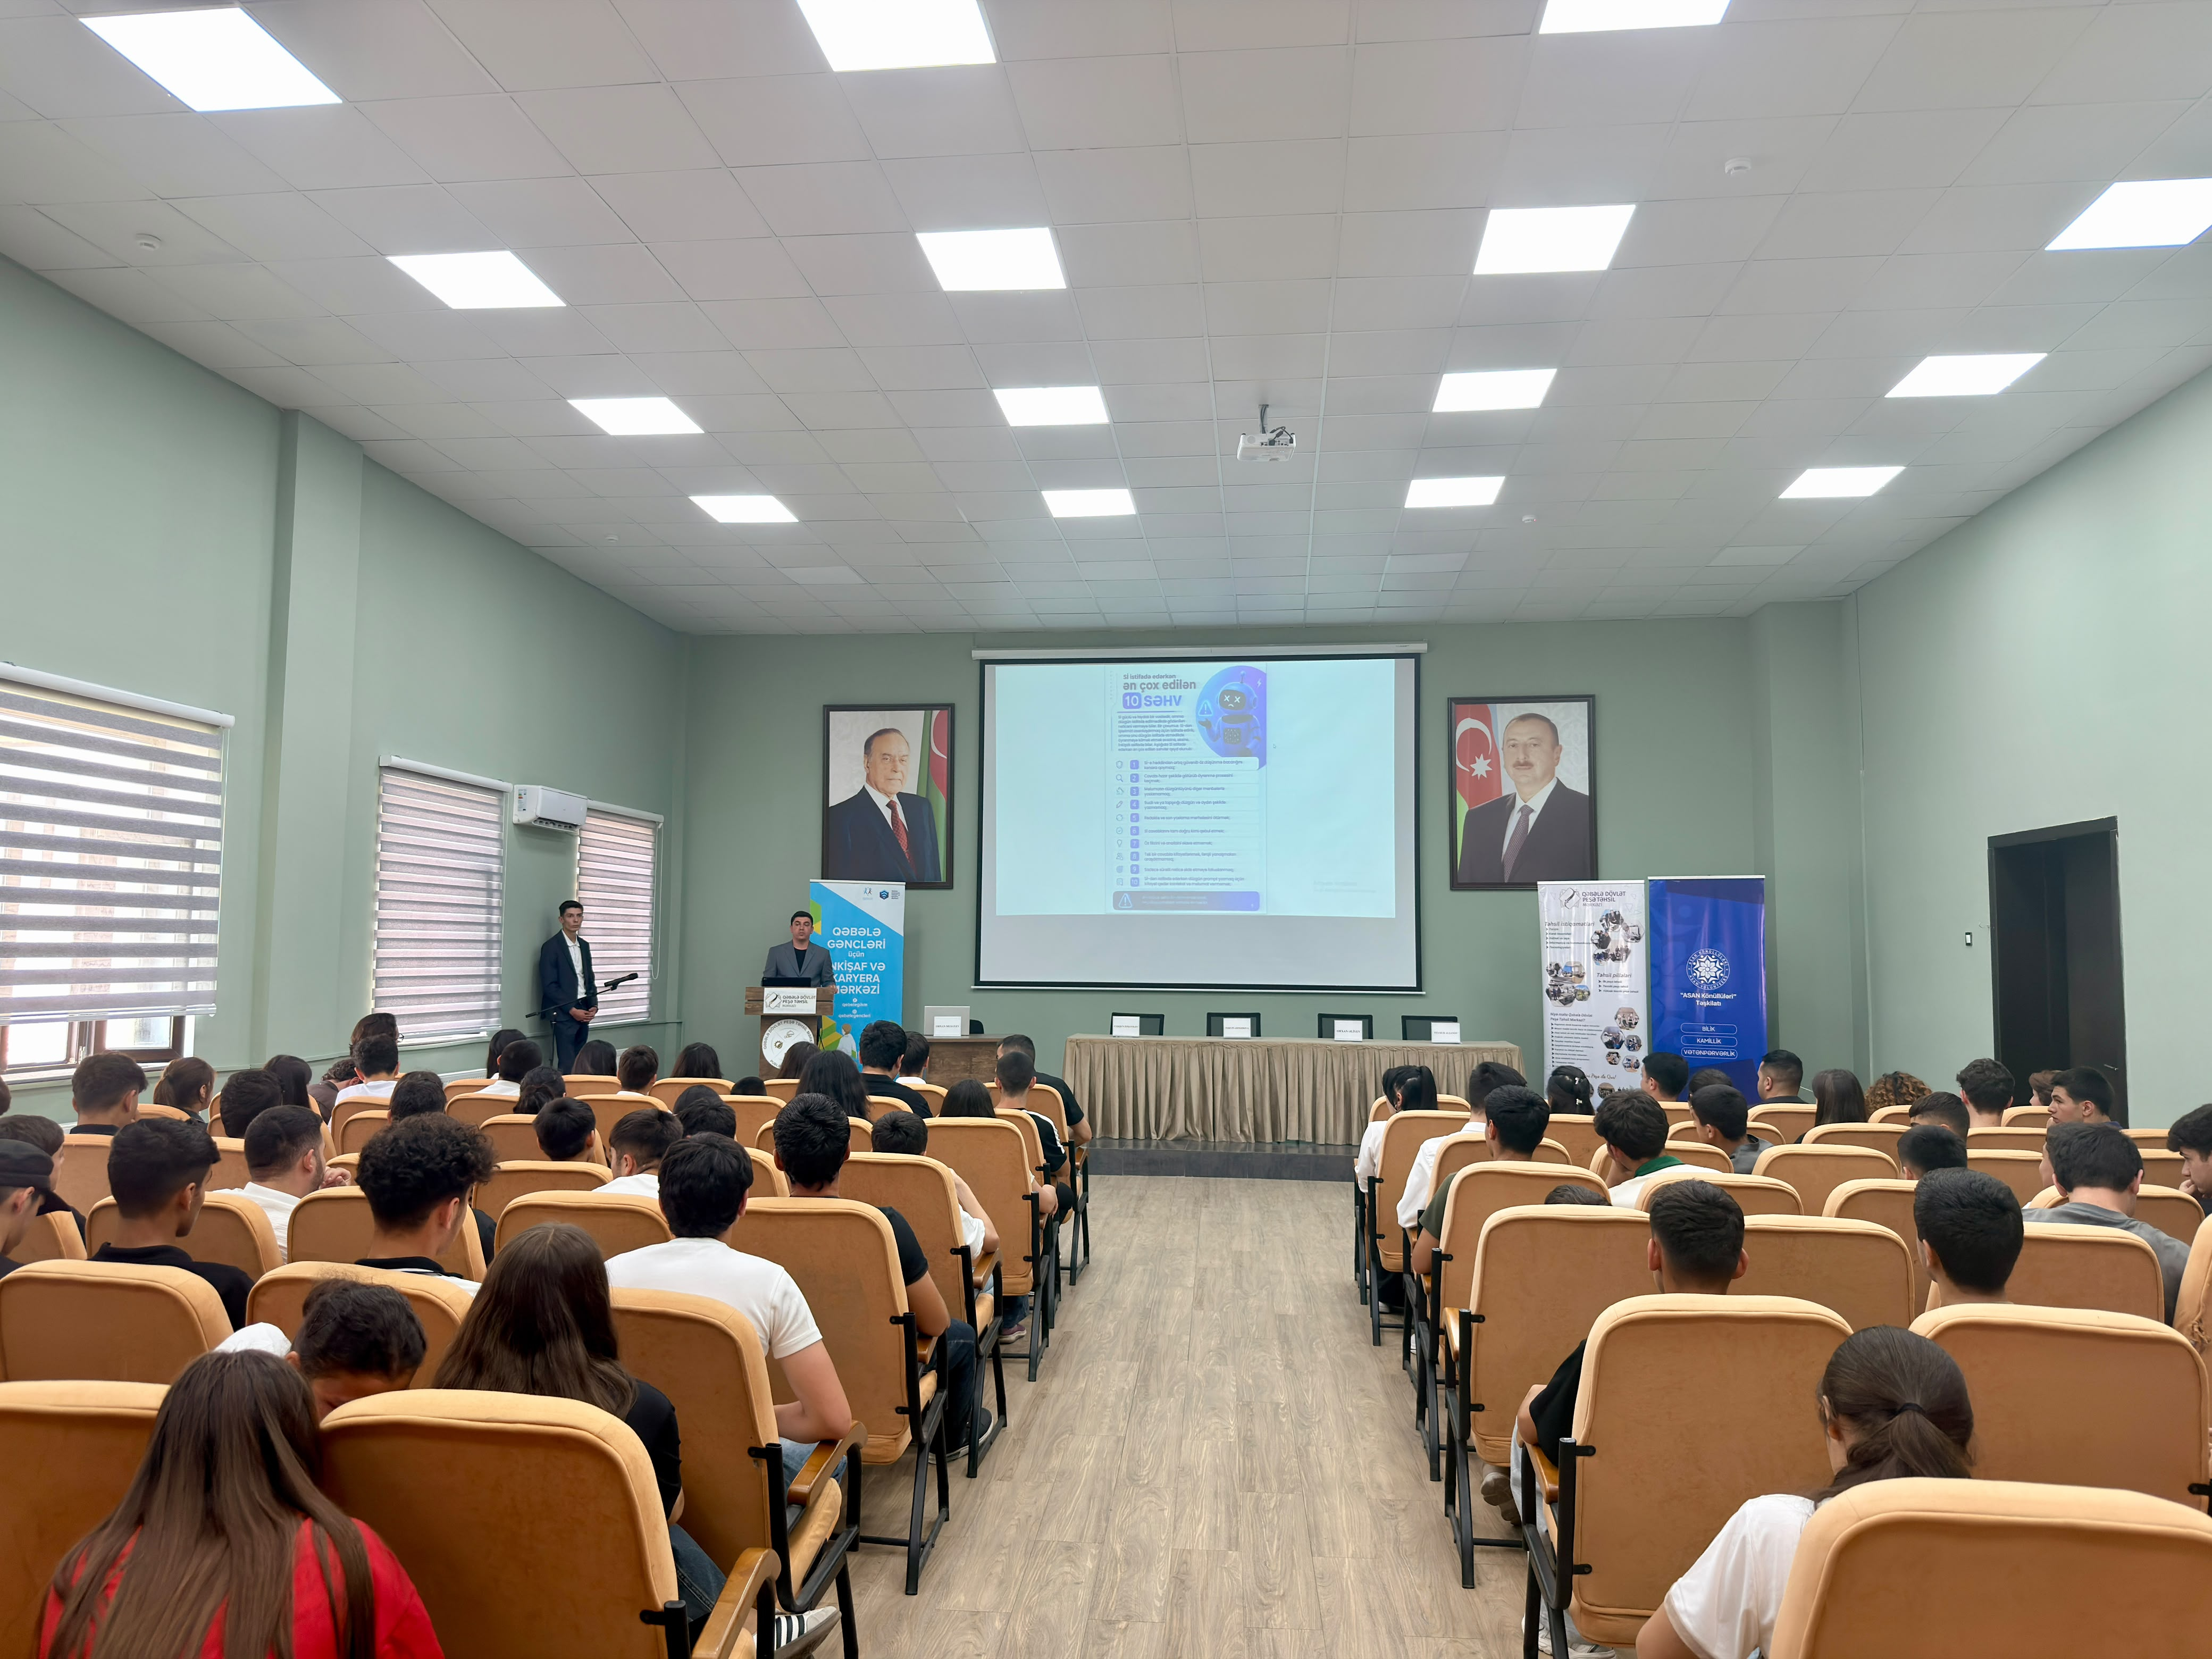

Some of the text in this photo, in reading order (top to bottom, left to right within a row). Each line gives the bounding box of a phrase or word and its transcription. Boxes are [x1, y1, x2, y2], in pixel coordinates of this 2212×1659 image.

[1139, 682, 1160, 693] çox
[1162, 679, 1196, 690] edilən
[1125, 695, 1182, 707] 10 SƏHV
[833, 927, 881, 936] QƏBƏLƏ
[827, 939, 886, 949] GƏNCLƏRİ
[832, 960, 886, 973] NKİŞAF VƏ
